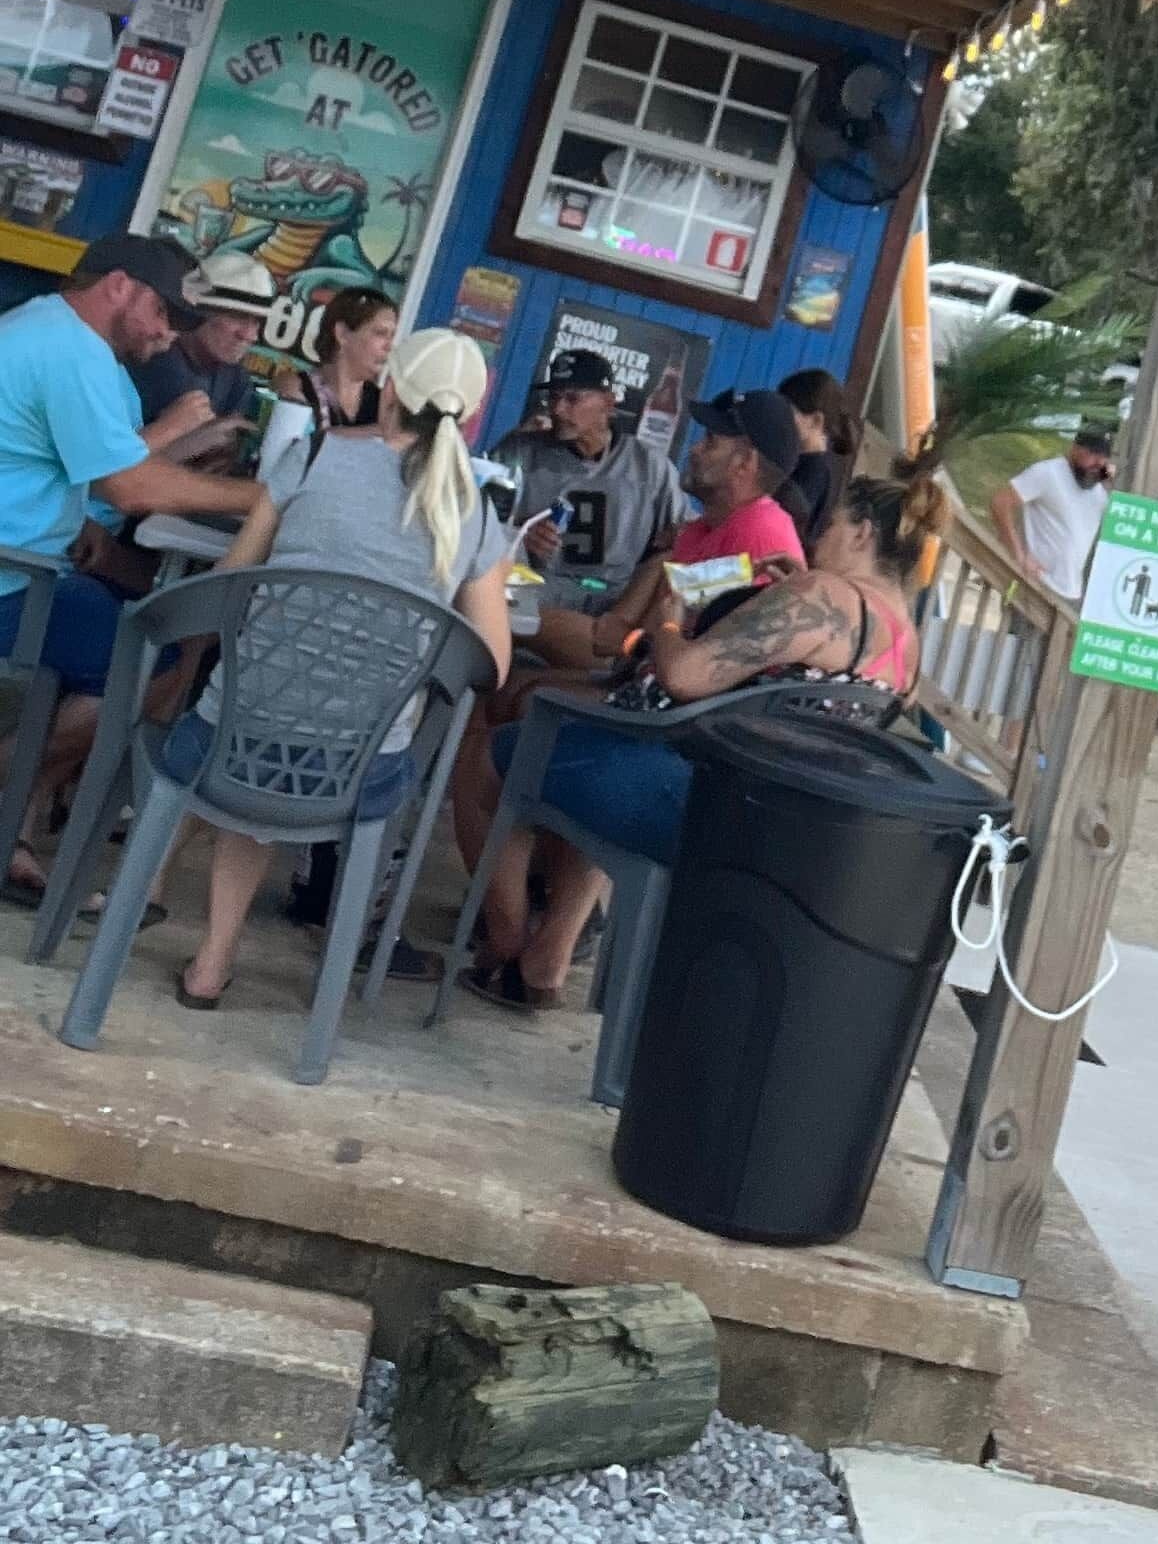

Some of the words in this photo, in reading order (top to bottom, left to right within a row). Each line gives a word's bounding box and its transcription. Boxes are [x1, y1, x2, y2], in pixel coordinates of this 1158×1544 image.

[129, 54, 161, 75] NO
[225, 35, 283, 86] GET
[305, 93, 352, 130] AT
[559, 313, 619, 343] PROUD
[1110, 501, 1146, 522] PETS
[560, 489, 607, 565] 9
[1114, 522, 1138, 539] ON
[1141, 528, 1153, 543] A
[1082, 631, 1124, 654] PLEASE
[1080, 652, 1118, 672] AFTER
[1121, 659, 1154, 681] YOUR
